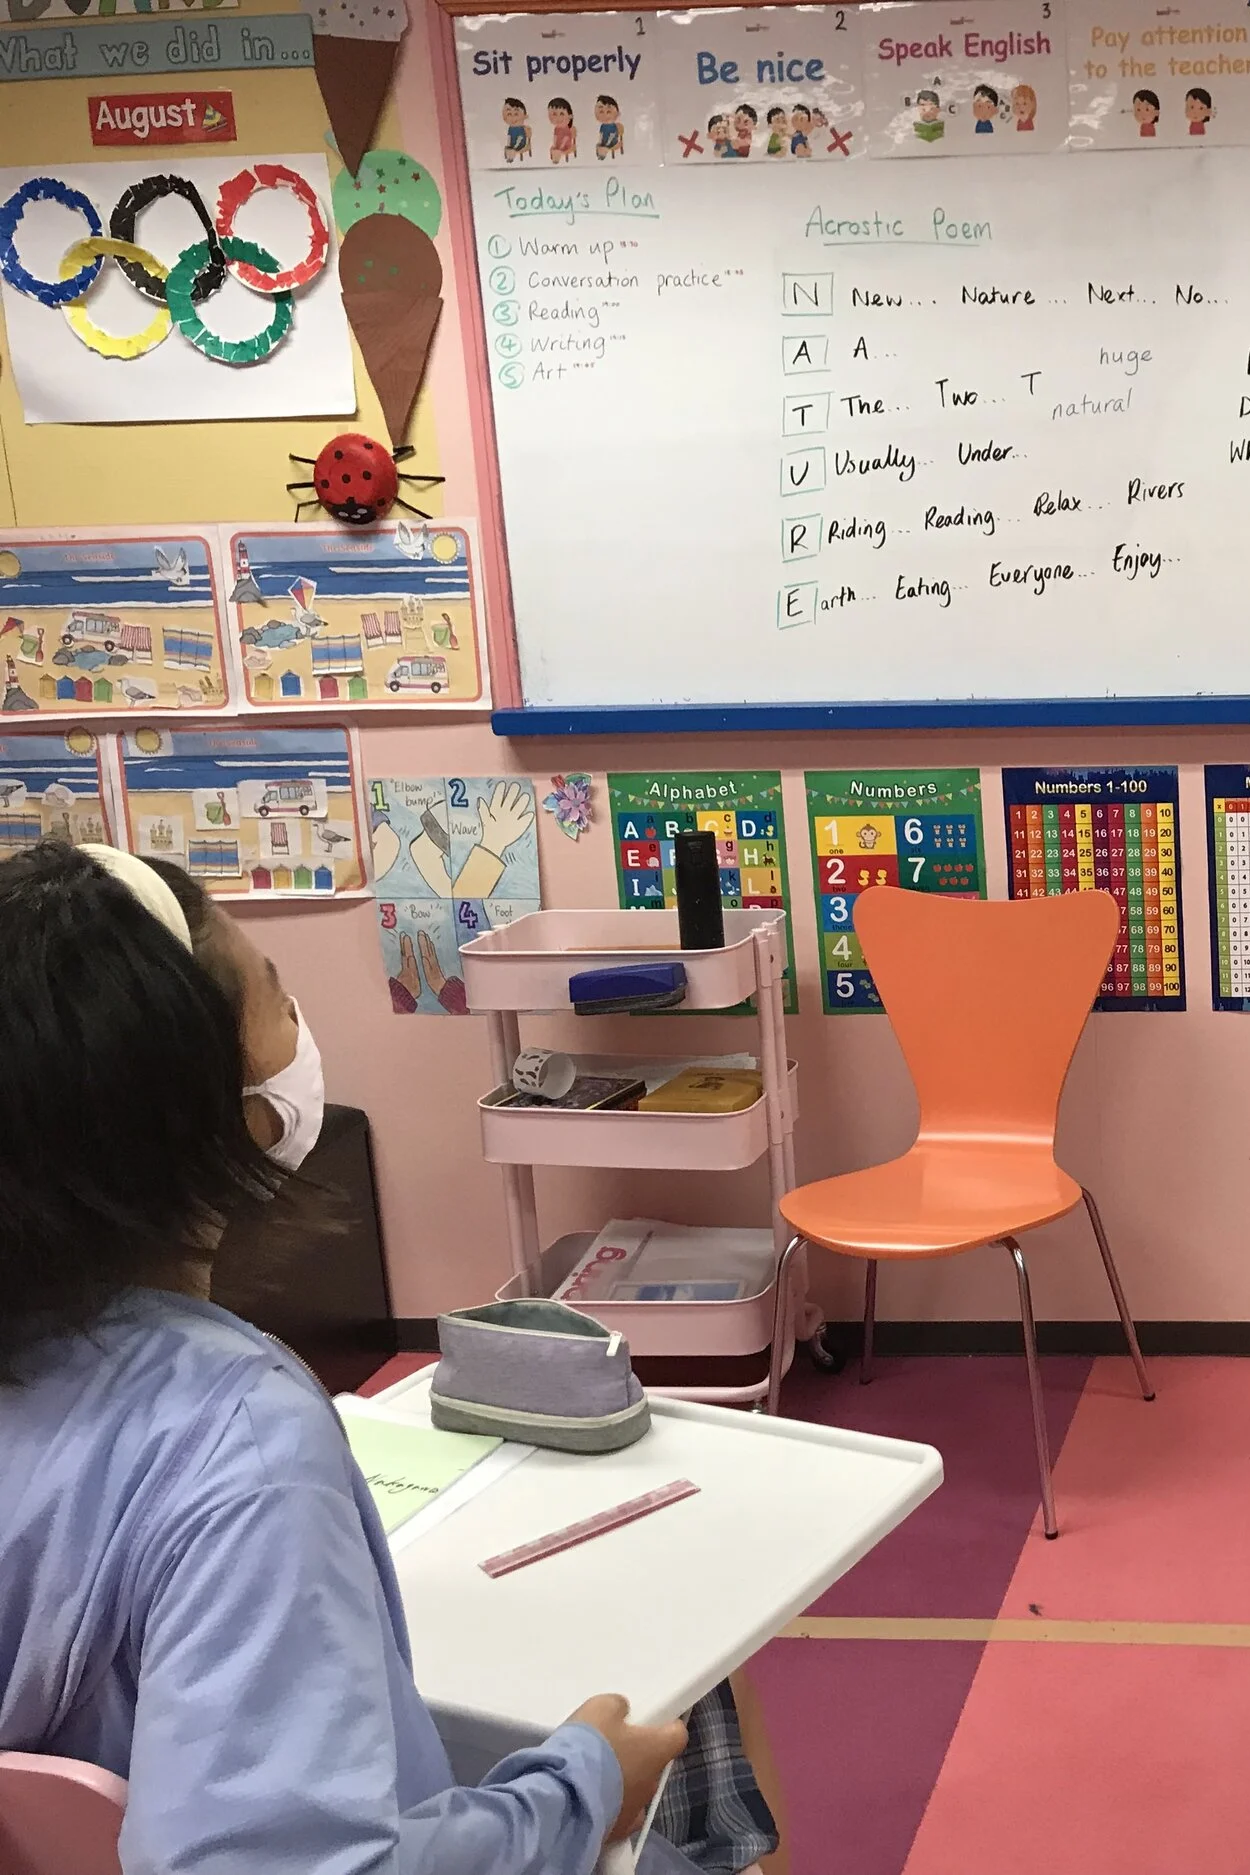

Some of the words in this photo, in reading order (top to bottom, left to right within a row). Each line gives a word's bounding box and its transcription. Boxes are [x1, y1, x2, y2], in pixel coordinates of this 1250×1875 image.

[101, 38, 149, 68] we
[167, 25, 220, 63] did
[878, 34, 953, 65] Speak
[964, 32, 1051, 62] English
[1092, 27, 1128, 53] Pay
[1141, 25, 1248, 46] attention
[473, 50, 512, 76] Sit
[526, 46, 641, 81] properly
[697, 52, 740, 84] Be
[757, 52, 825, 83] nice
[1084, 59, 1107, 78] to
[1117, 57, 1156, 78] the
[96, 98, 196, 138] August
[494, 186, 590, 225] Today's
[606, 177, 655, 209] Plan
[805, 205, 904, 238] Acrostic
[933, 208, 992, 240] Poem
[520, 237, 578, 256] Warm
[590, 241, 614, 264] up
[528, 271, 639, 288] Conversation
[658, 270, 722, 296] practice
[529, 302, 600, 328] Reading
[531, 335, 605, 359] Writing
[532, 362, 567, 380] Art
[1099, 346, 1152, 376] huge
[1021, 372, 1041, 395] T
[1052, 389, 1132, 420] natural
[1128, 478, 1184, 505] Rivers
[650, 781, 737, 801] Alphabet
[851, 781, 937, 798] Numbers
[1035, 780, 1101, 794] Numbers
[1107, 780, 1147, 793] 1-100
[904, 818, 923, 845] 6
[826, 859, 846, 885] 2
